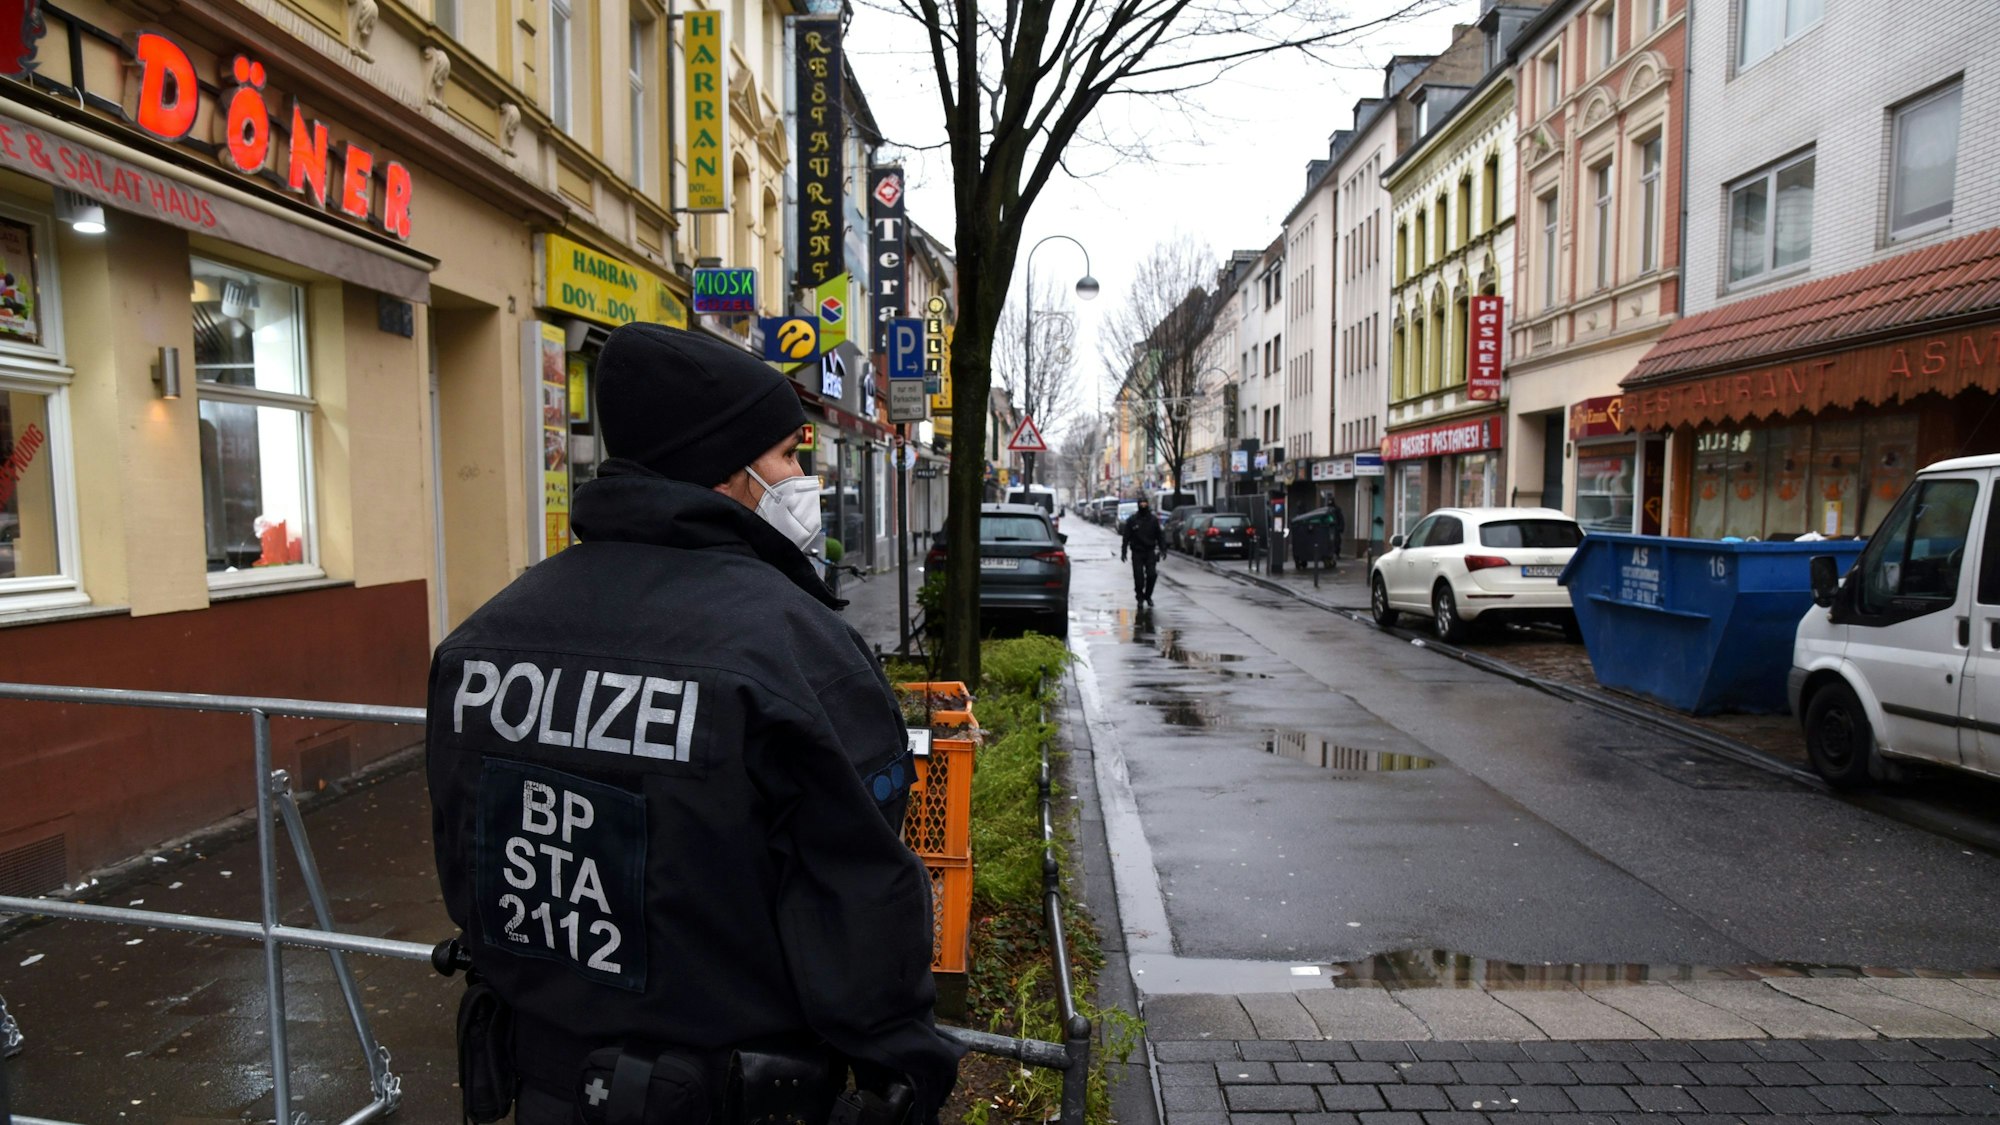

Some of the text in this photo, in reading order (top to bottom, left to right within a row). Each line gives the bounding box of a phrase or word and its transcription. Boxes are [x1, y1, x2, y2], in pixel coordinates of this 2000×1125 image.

[691, 15, 717, 177] HARRAN
[137, 32, 412, 241] DÖNER
[805, 31, 834, 283] RESTAURANT
[25, 132, 55, 173] &
[58, 146, 143, 197] SALAT
[149, 178, 217, 228] HAUS
[573, 250, 638, 292] HARRAN
[696, 271, 753, 295] KIOSK
[896, 326, 916, 371] P
[1478, 300, 1498, 377] HASRET
[1625, 359, 1835, 415] RESTAURANT
[1400, 433, 1430, 458] HASRET
[1632, 547, 1726, 577] AS 16
[453, 659, 700, 763] POLIZEI
[521, 779, 595, 844] BP
[502, 836, 613, 915] STA
[498, 893, 622, 975] 2112
